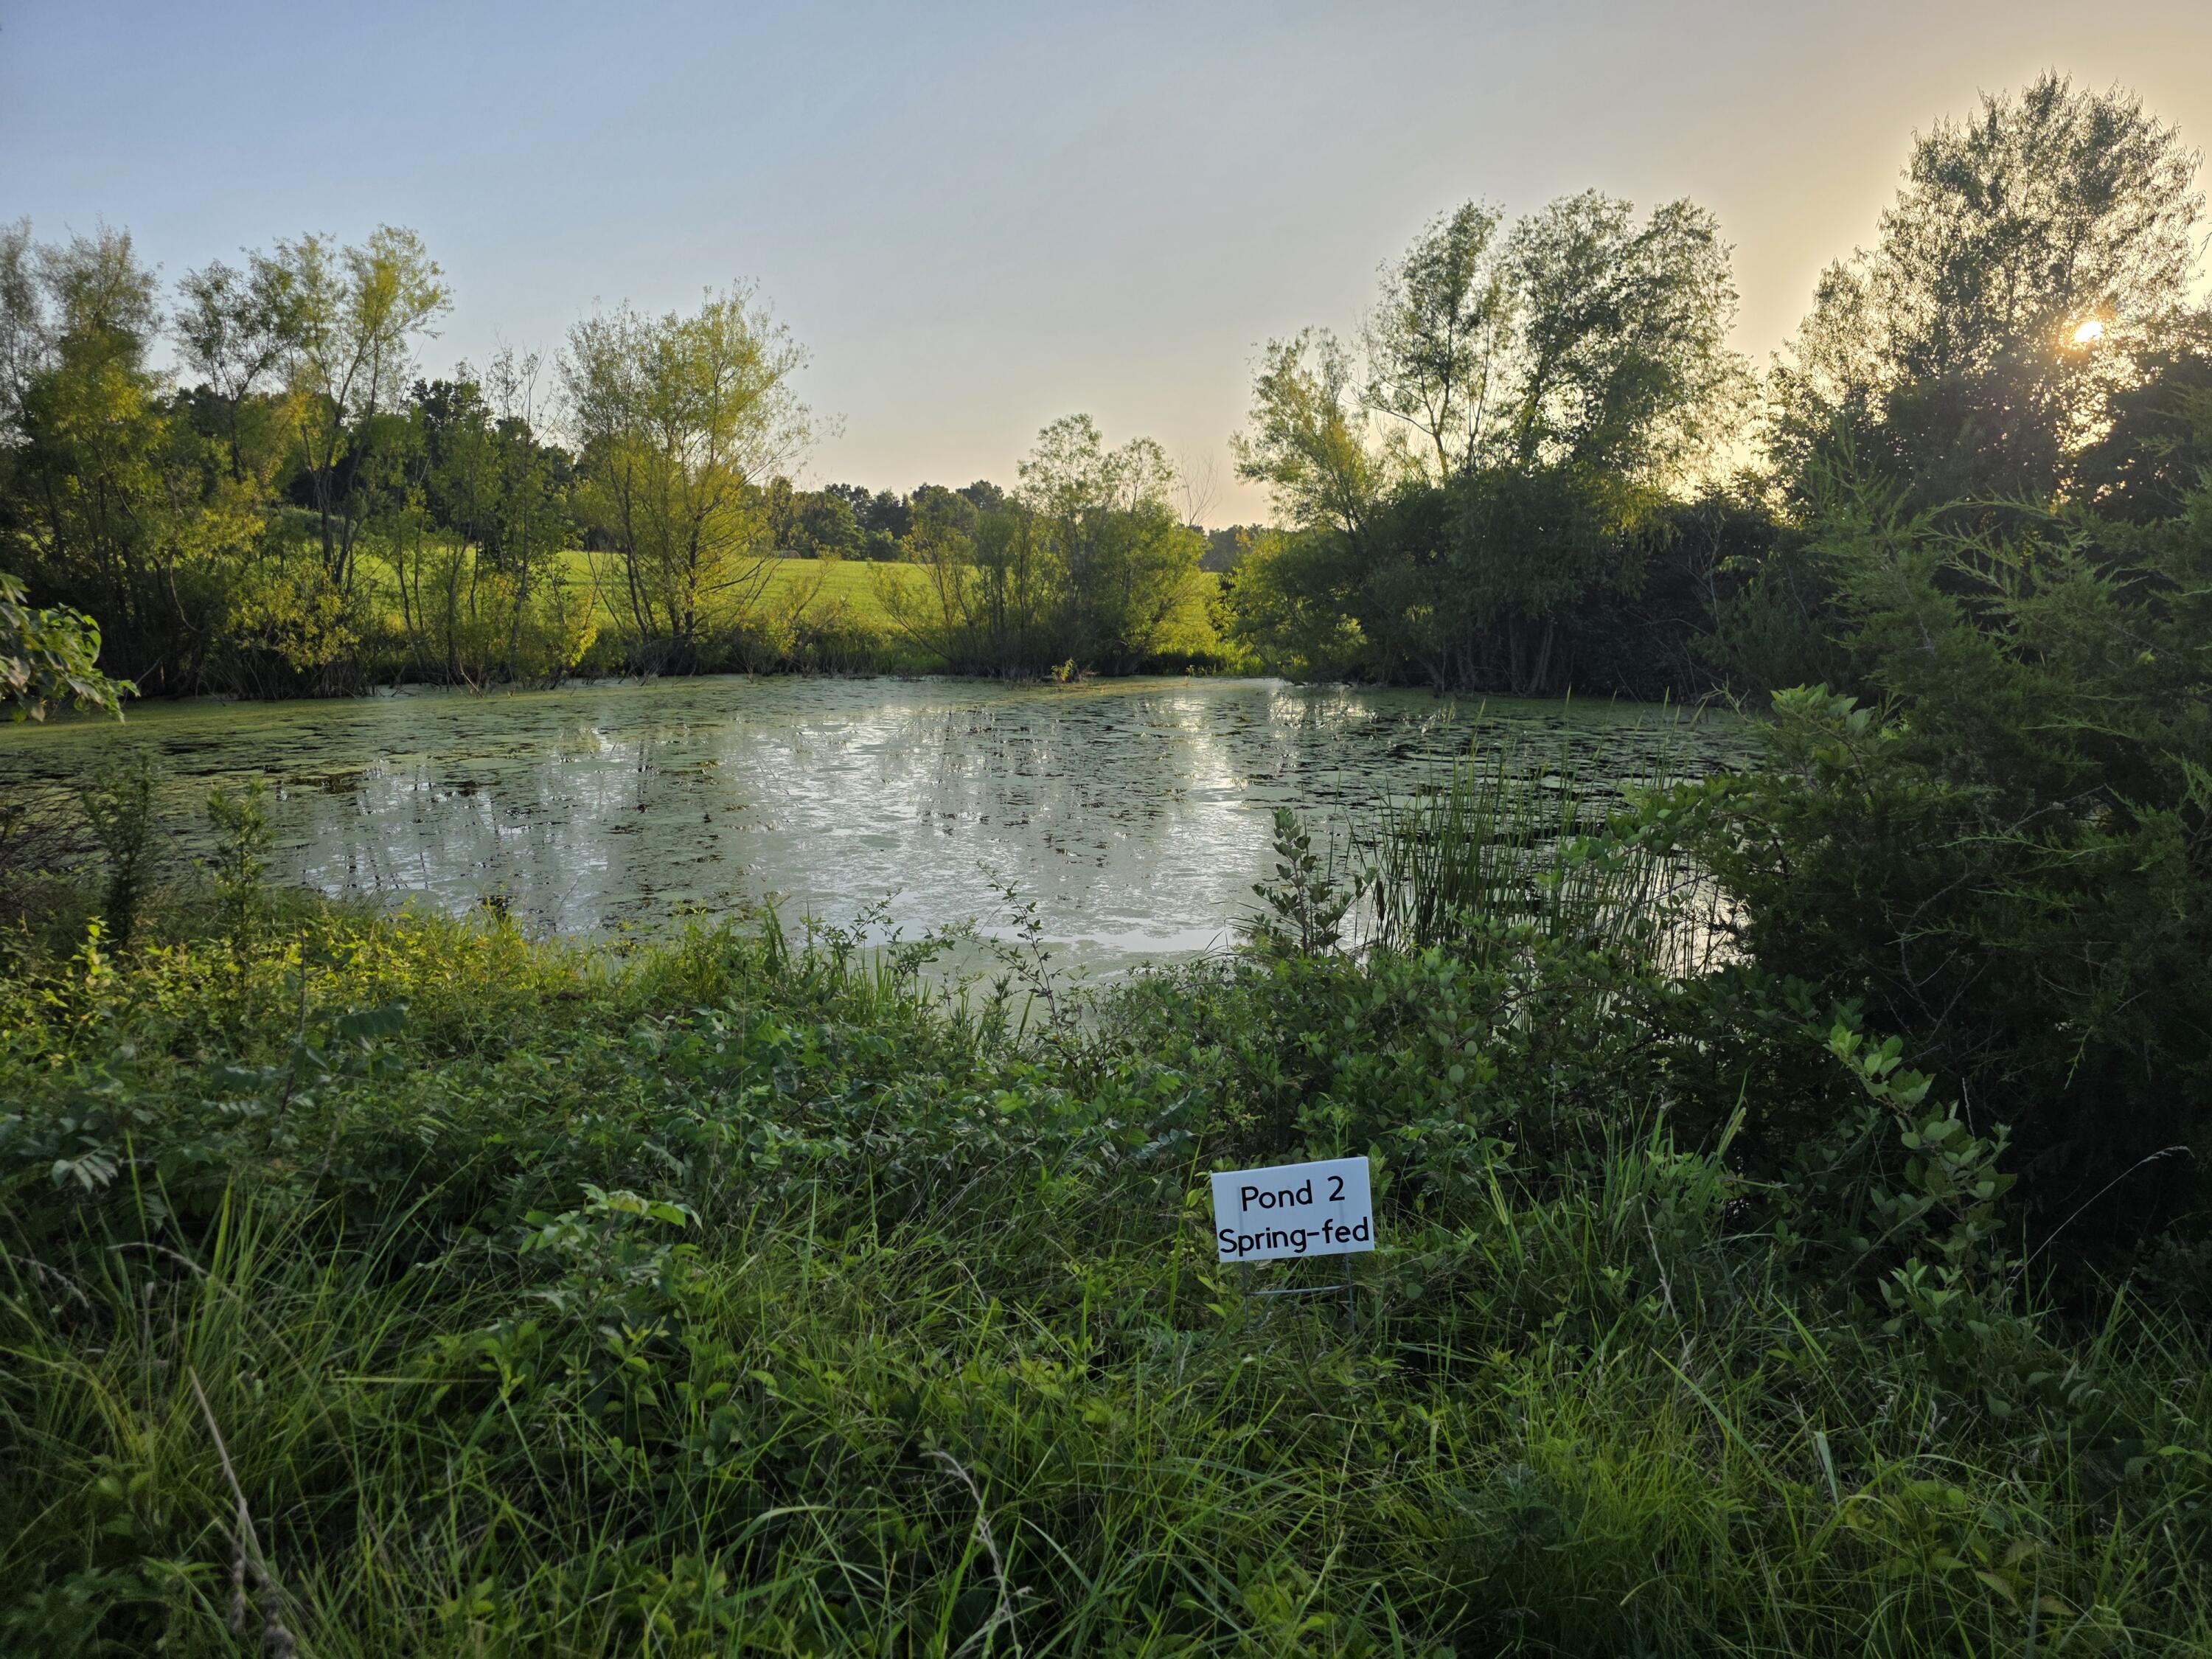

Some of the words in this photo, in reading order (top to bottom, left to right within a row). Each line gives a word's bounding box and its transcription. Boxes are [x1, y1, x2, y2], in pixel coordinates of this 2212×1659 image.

[1241, 1179, 1312, 1211] Pond
[1327, 1175, 1345, 1201] 2
[1219, 1217, 1369, 1256] Spring-fed
